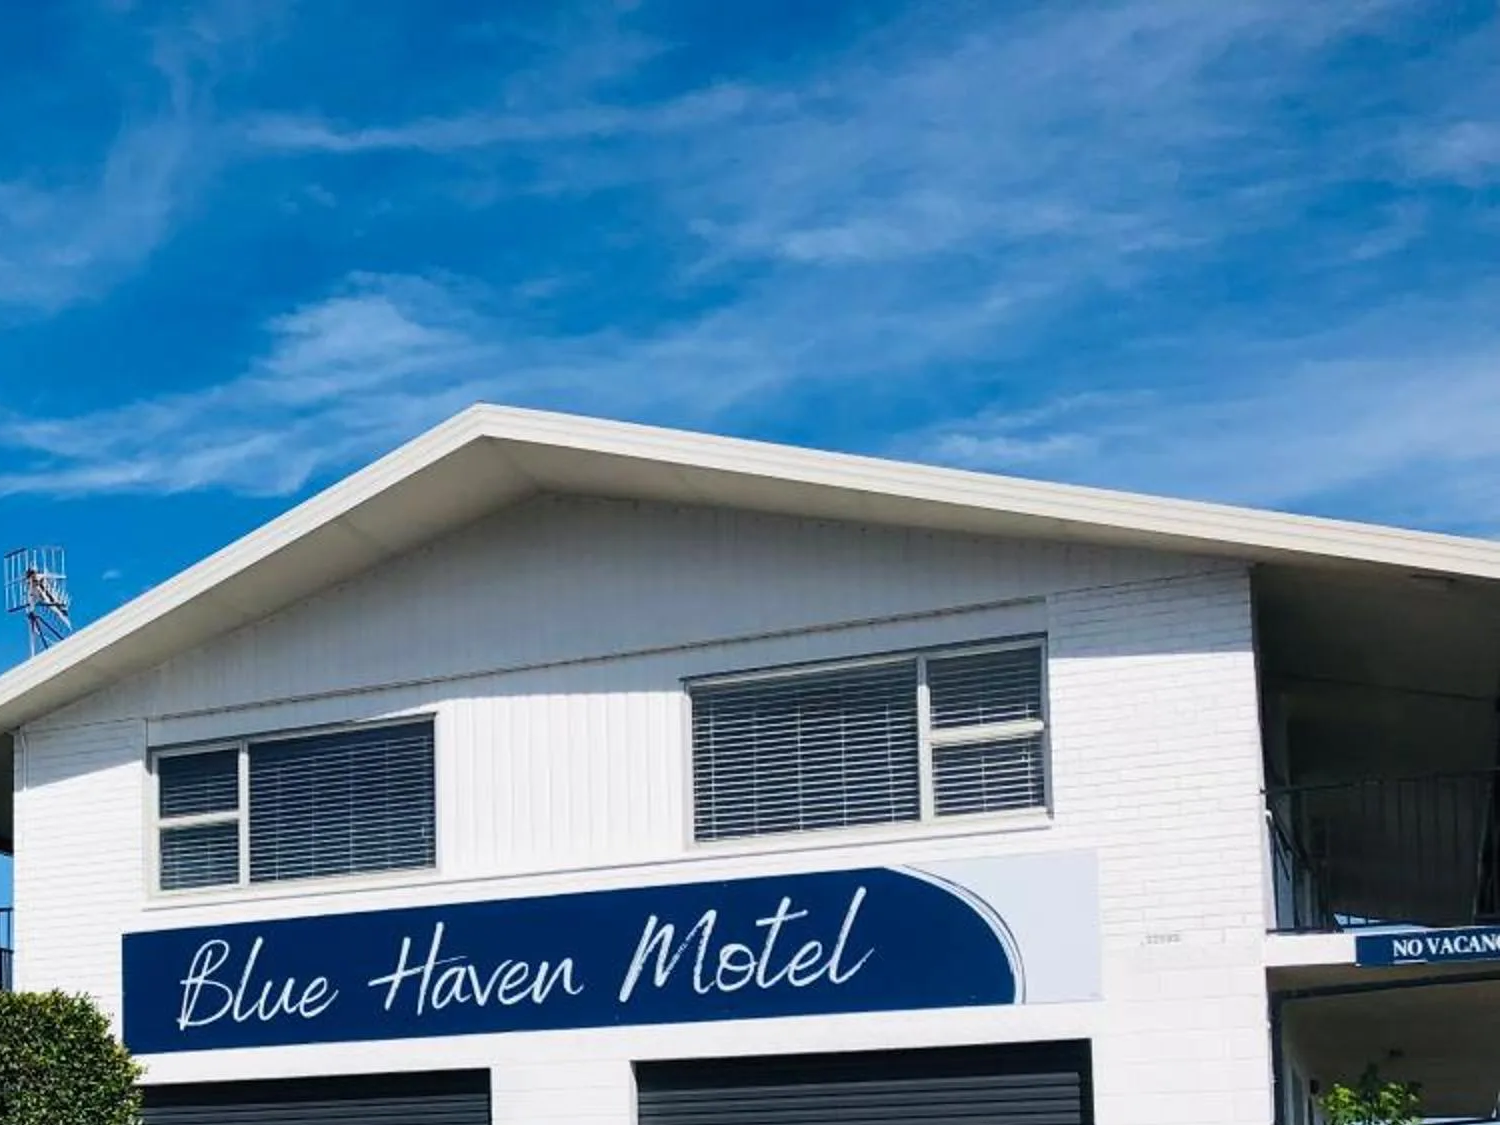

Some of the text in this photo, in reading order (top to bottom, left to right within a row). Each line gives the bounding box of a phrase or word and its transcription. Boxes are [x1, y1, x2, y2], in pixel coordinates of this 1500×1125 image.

[177, 886, 876, 1031] Blue Haven Motel
[1392, 939, 1423, 957] NO
